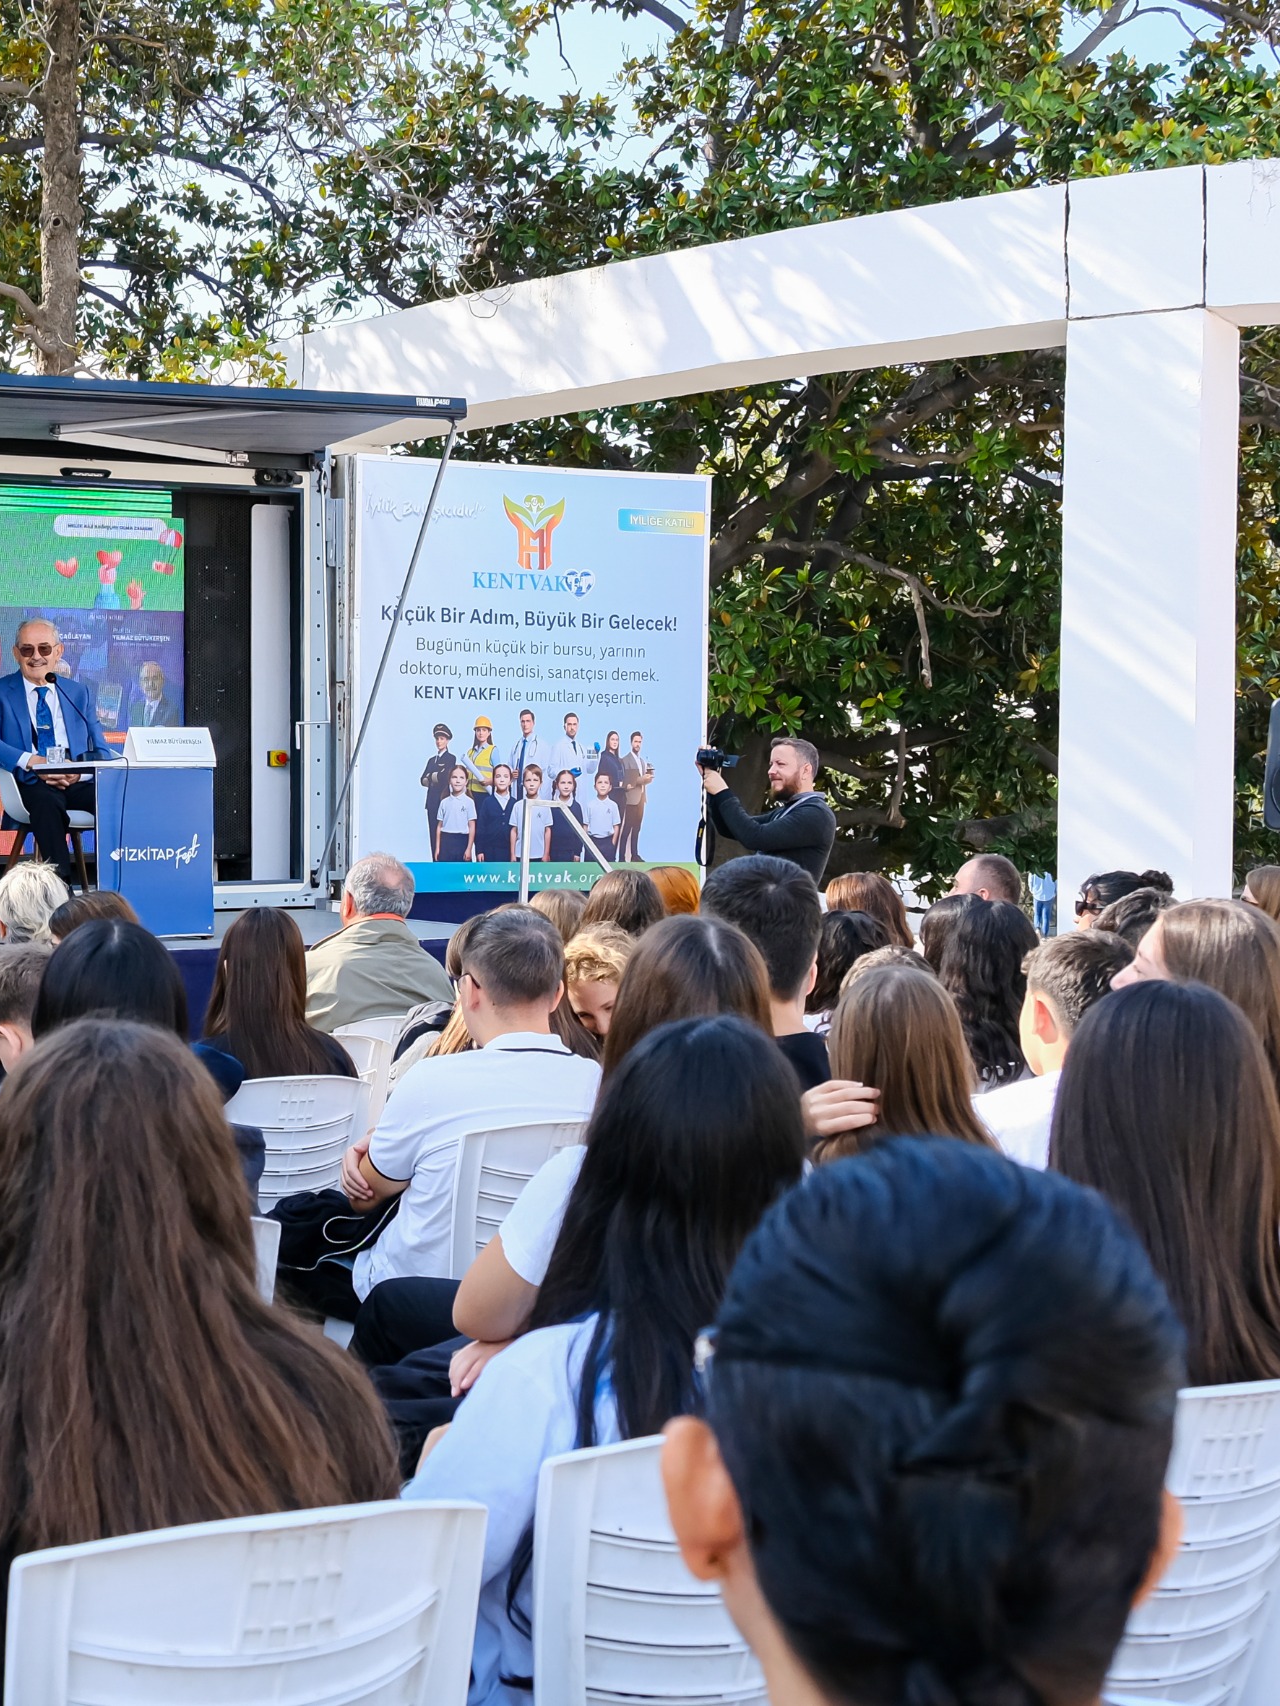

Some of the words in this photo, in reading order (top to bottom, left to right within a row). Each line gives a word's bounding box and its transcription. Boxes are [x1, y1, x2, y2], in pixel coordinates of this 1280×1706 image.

[441, 607, 465, 623] Bir
[470, 608, 520, 628] Adım,
[524, 611, 577, 631] Büyük
[582, 613, 604, 629] Bir
[609, 614, 678, 632] Gelecek!
[416, 637, 481, 655] Bugünün
[485, 639, 527, 657] küçük
[530, 641, 549, 655] bir
[553, 642, 596, 660] bursu,
[600, 645, 646, 660] yarının
[399, 660, 462, 678] doktoru,
[466, 662, 545, 681] mühendisi,
[548, 667, 608, 683] sanatçısı
[611, 668, 660, 682] demek.
[414, 685, 455, 700] KENT
[458, 686, 501, 701] VAKFI
[505, 687, 522, 701] ile
[525, 689, 585, 703] umutları
[588, 690, 647, 707] yeşertin.
[125, 846, 175, 861] İZKİTAP
[175, 834, 200, 869] Fest
[464, 870, 604, 884] www.kntvak.or
